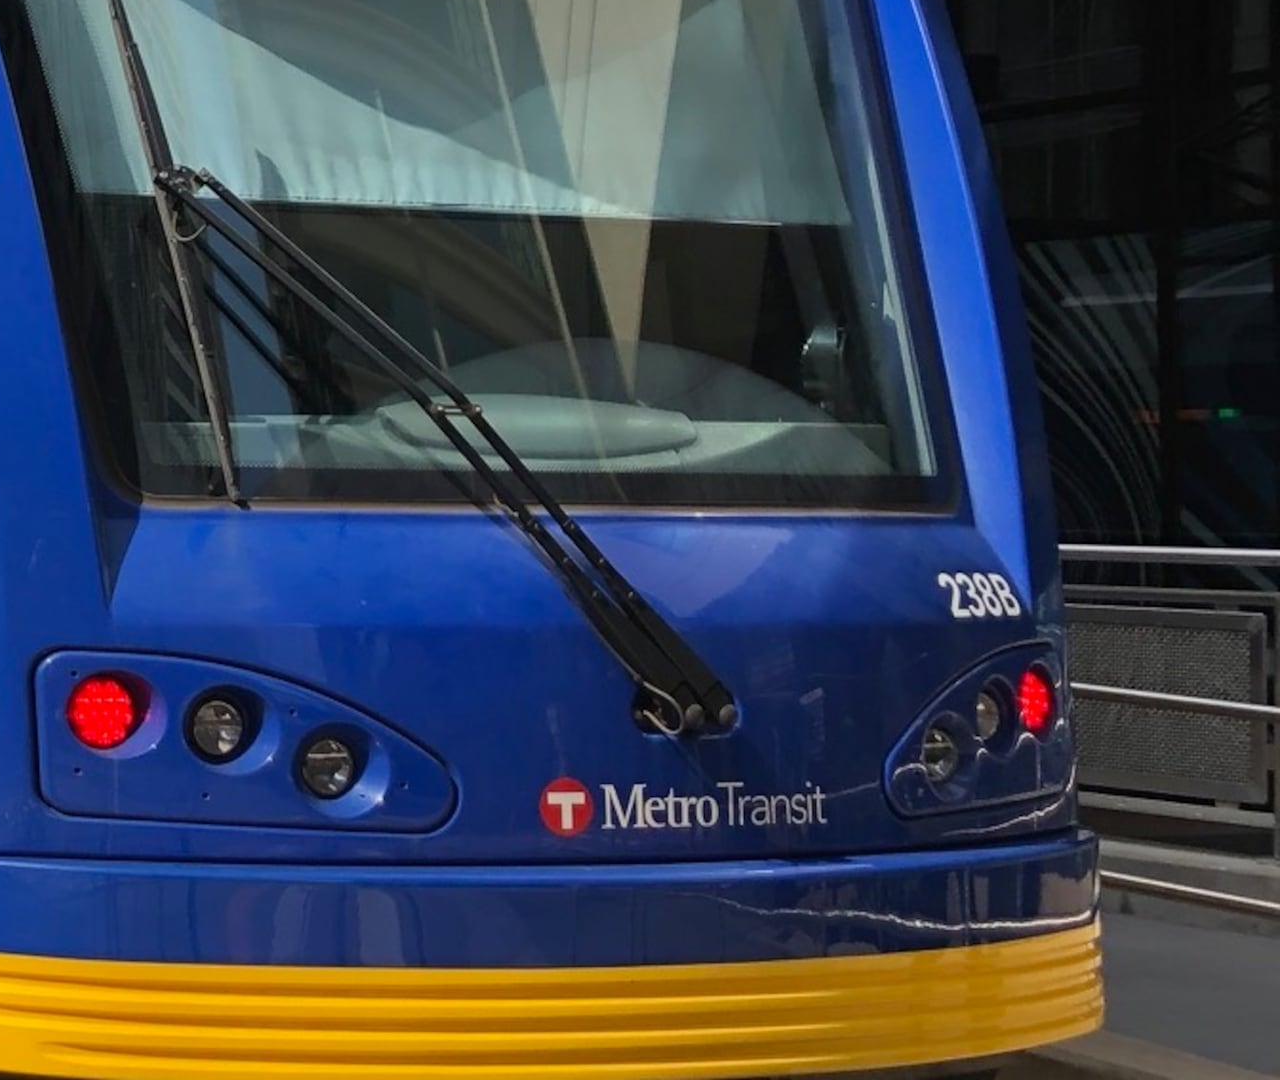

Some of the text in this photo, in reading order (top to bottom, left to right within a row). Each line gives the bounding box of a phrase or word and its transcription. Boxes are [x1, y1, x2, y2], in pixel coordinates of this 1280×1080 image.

[938, 571, 1021, 618] 238B
[600, 783, 718, 830] Metro
[717, 780, 828, 826] Transit
